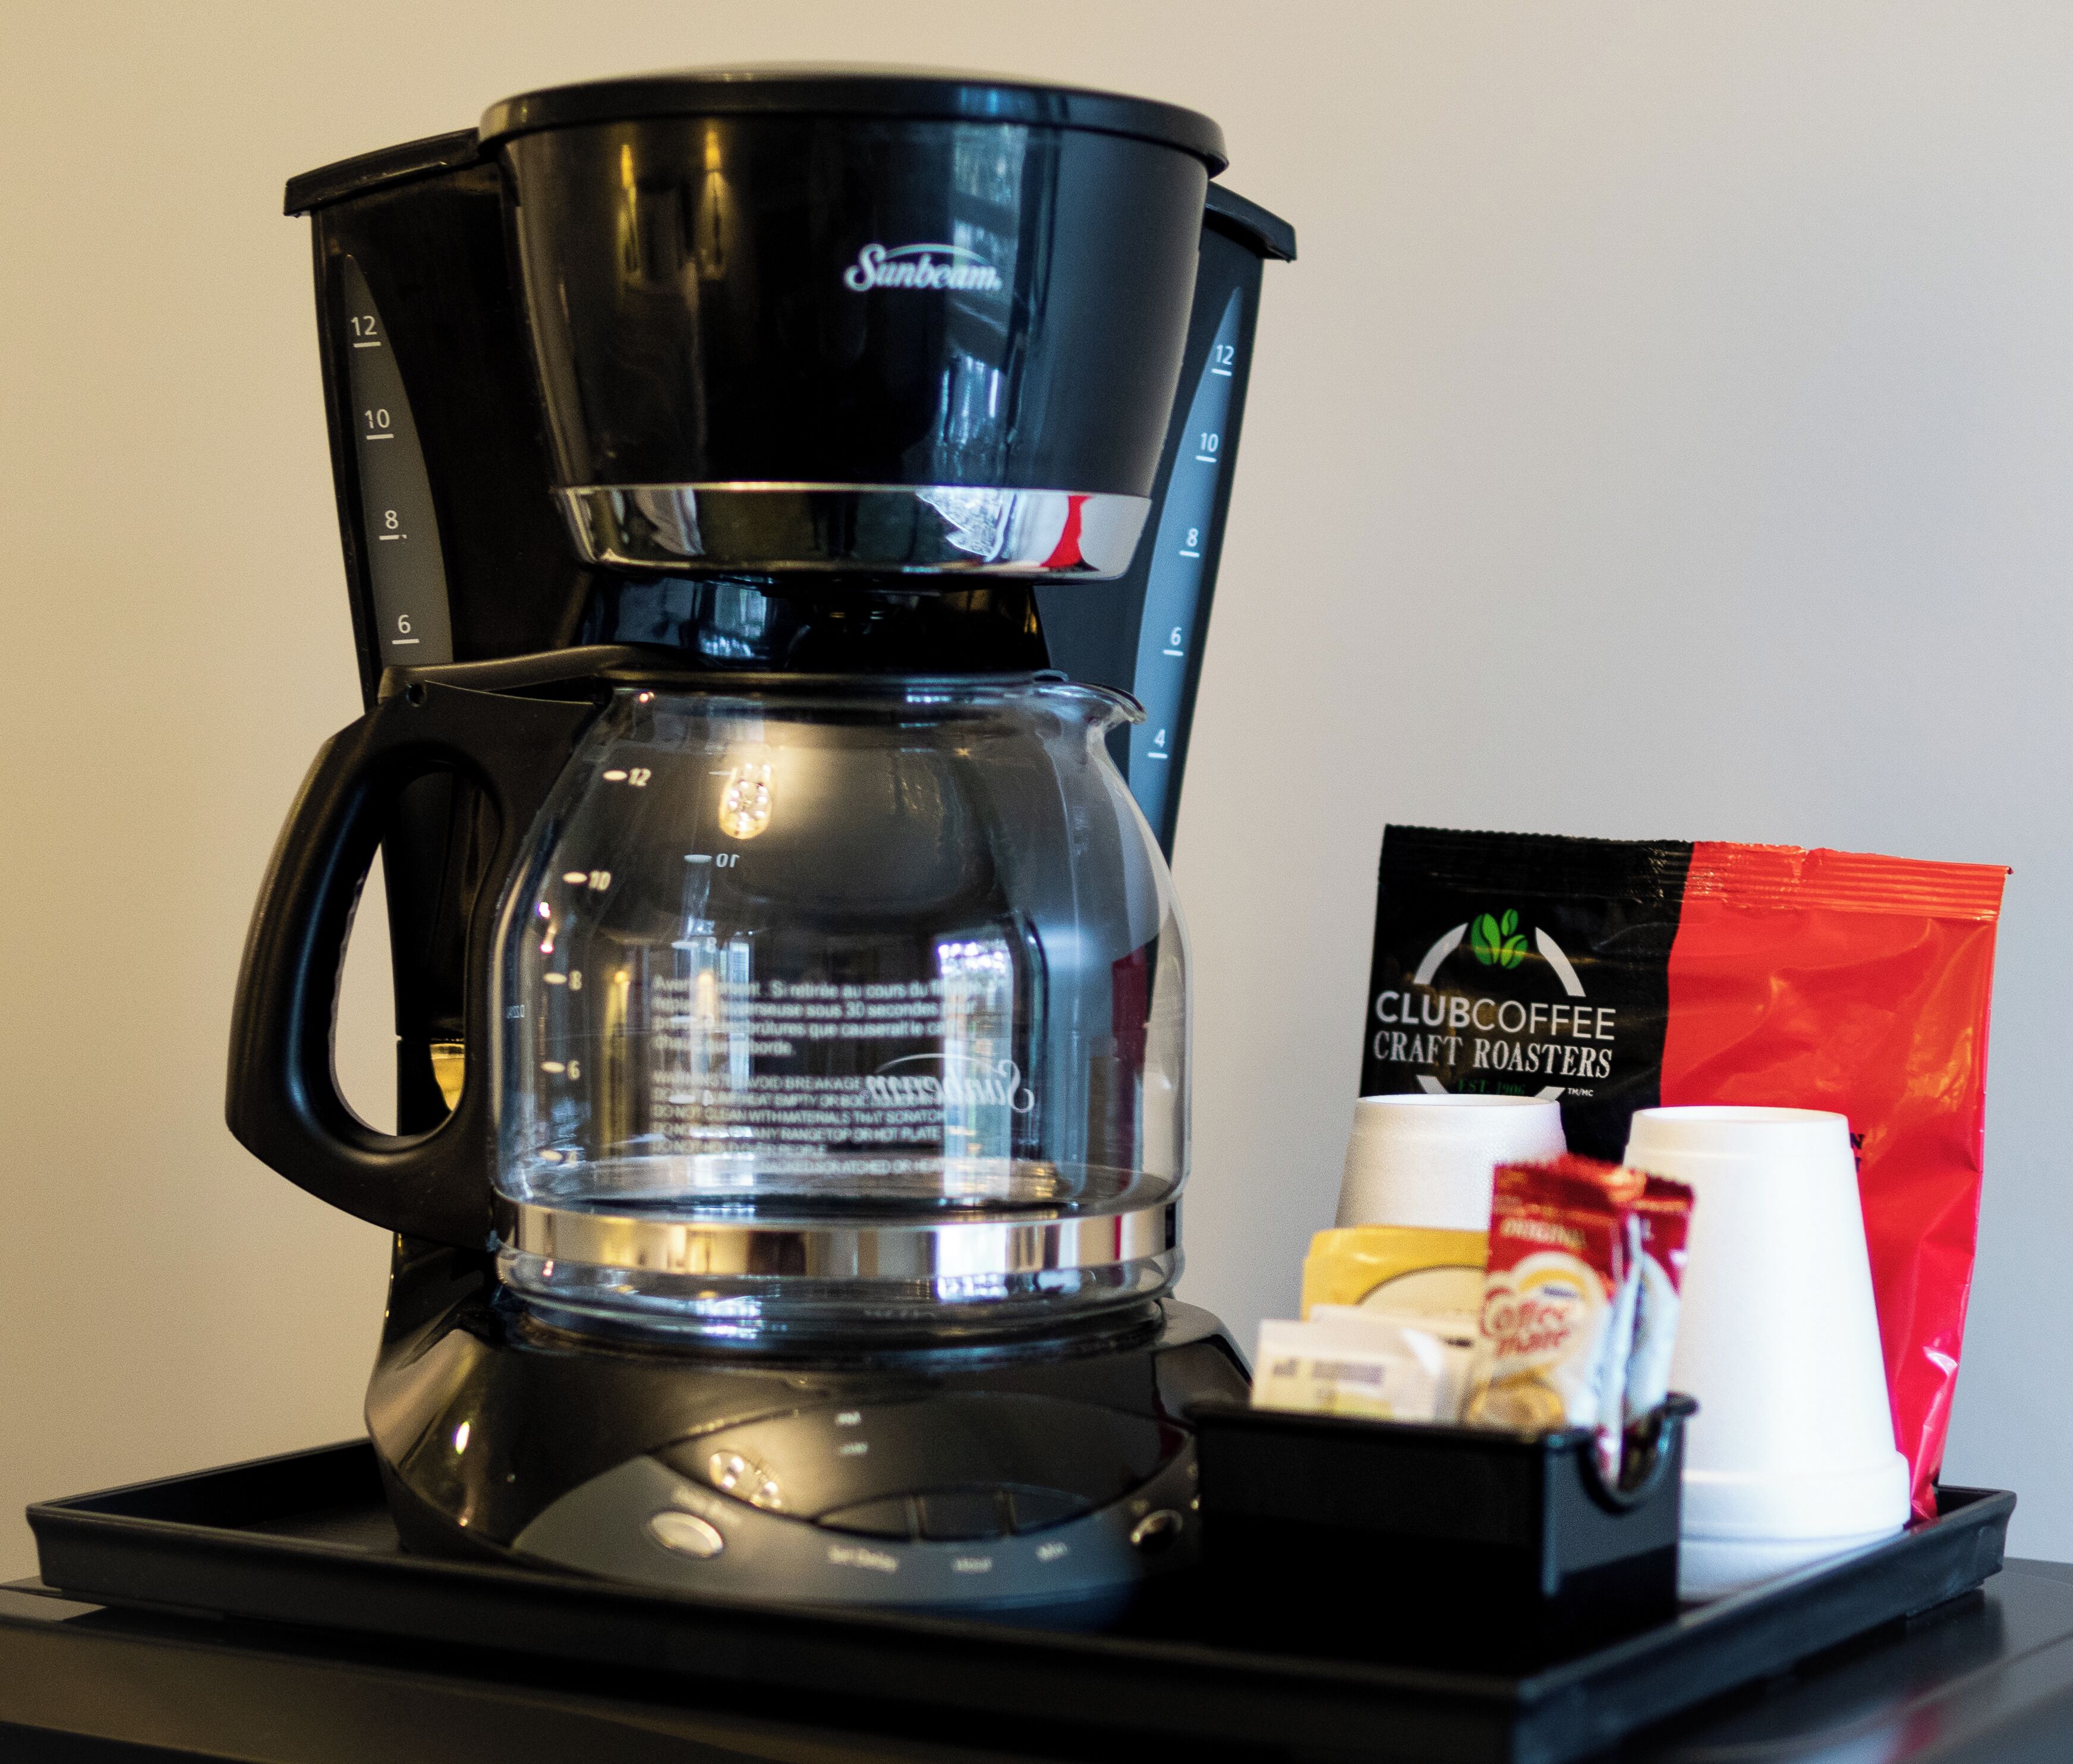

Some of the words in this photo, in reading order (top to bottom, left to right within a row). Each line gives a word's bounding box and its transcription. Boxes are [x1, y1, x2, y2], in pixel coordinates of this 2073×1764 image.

[843, 243, 1001, 292] Sunbeam
[351, 315, 377, 336] 12
[1215, 345, 1234, 366] 12
[364, 408, 390, 429] 10
[1200, 433, 1219, 453] 10
[385, 509, 399, 530] 8
[1187, 528, 1199, 547] 8
[396, 614, 411, 634] 6
[1170, 626, 1183, 646] 6
[1154, 729, 1165, 748] 4
[629, 768, 651, 787] 12
[588, 870, 611, 890] 10
[569, 969, 582, 991] 8
[1373, 1031, 1464, 1066] CRAFT
[1472, 1038, 1613, 1079] ROASTERS
[567, 1059, 581, 1081] 6
